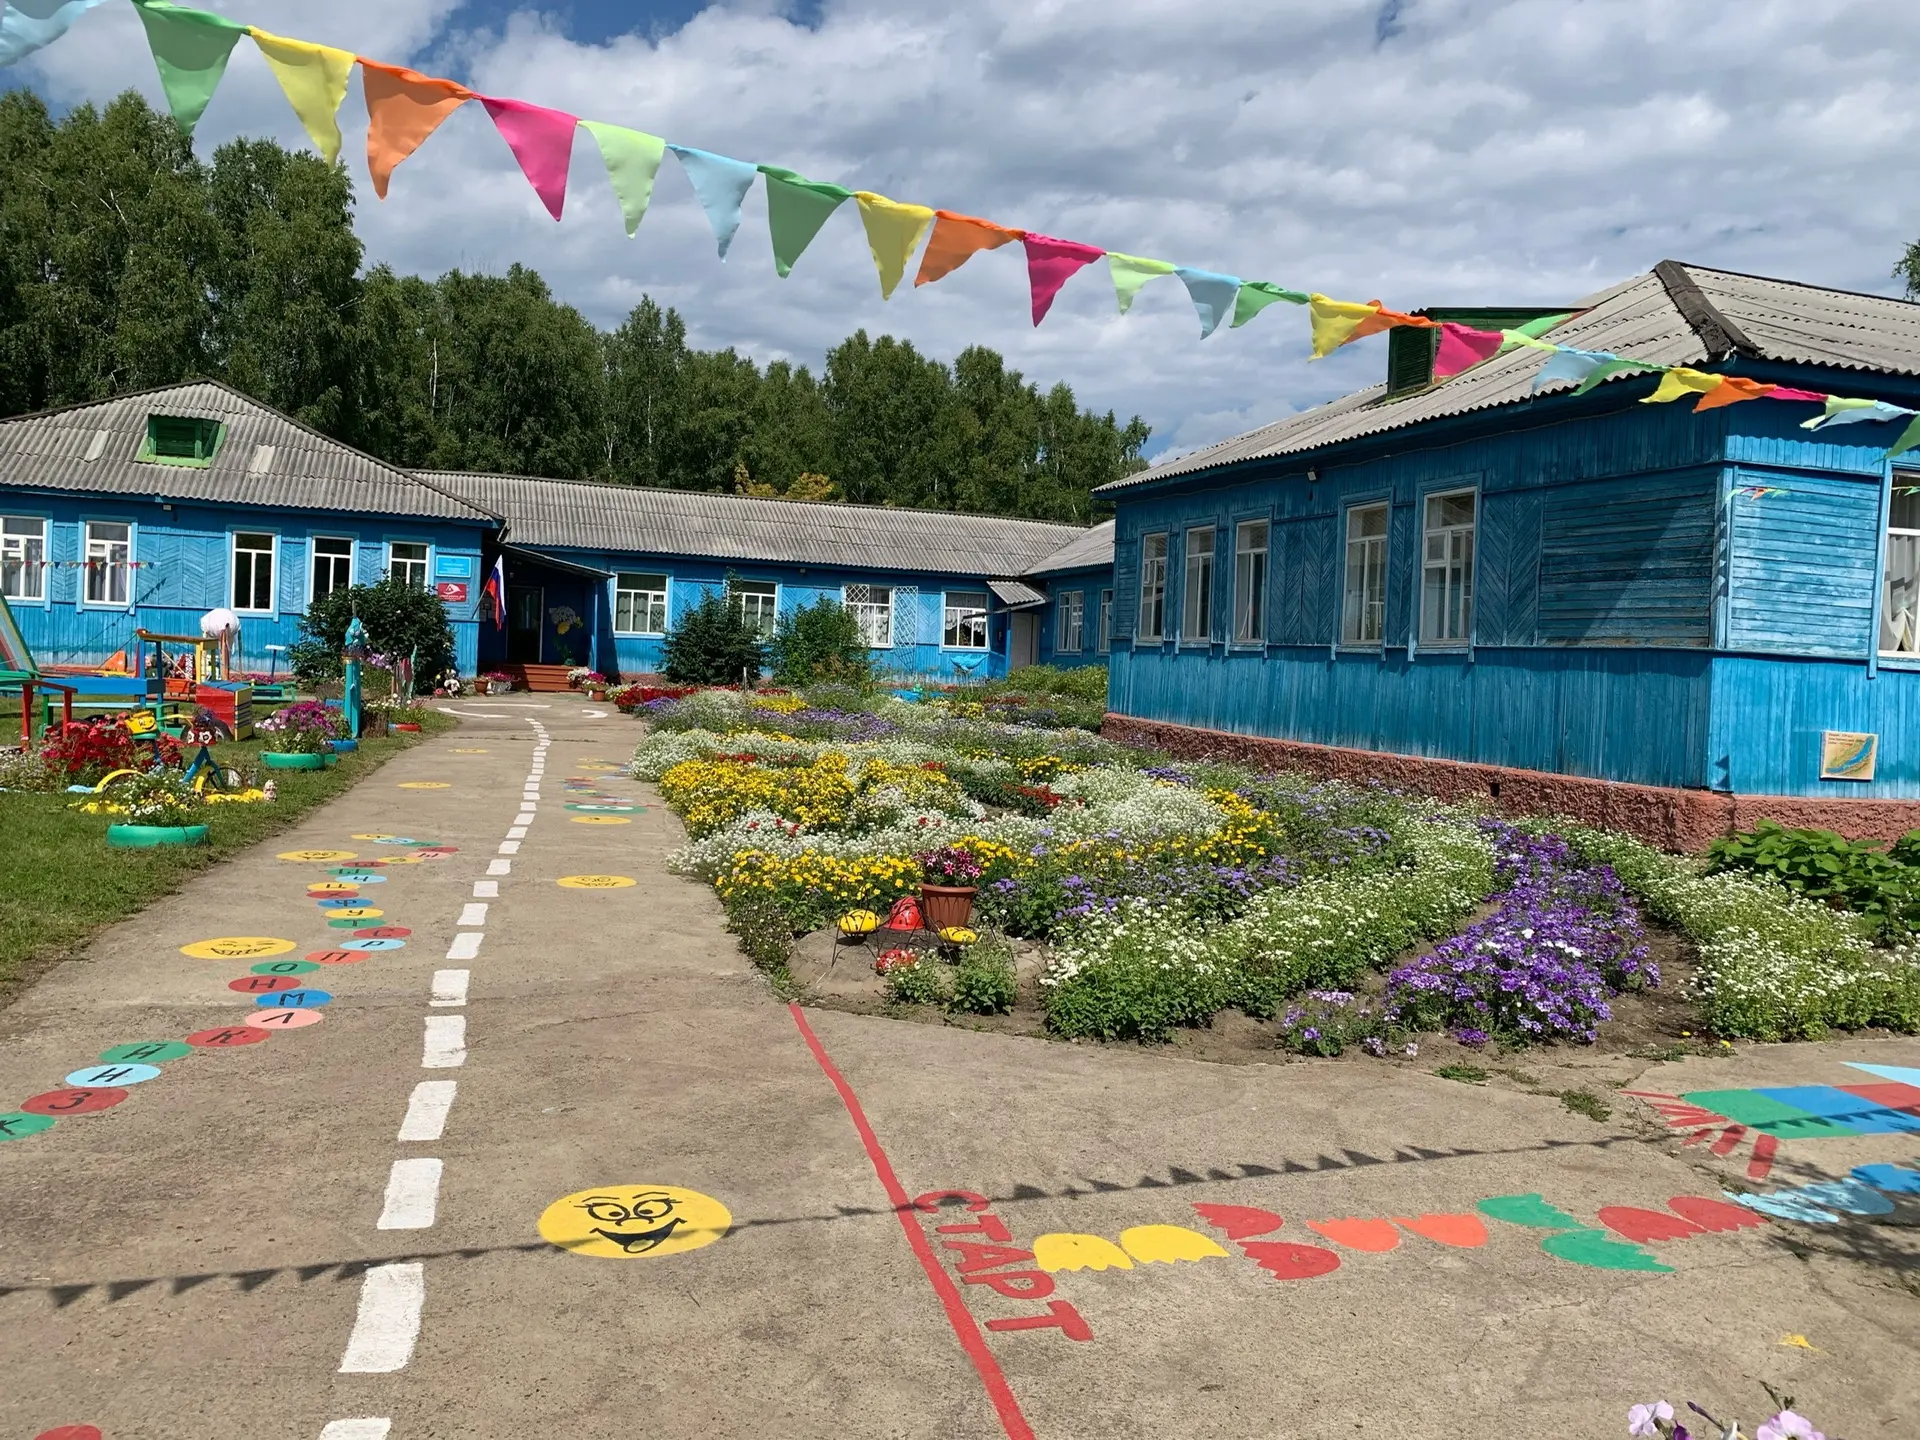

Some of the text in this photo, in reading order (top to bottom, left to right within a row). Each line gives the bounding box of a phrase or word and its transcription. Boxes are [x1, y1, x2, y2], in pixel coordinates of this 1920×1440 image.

[343, 919, 366, 927] Т
[373, 928, 395, 937] С
[361, 940, 385, 948] Р
[320, 952, 350, 962] П
[270, 962, 298, 973] О
[249, 978, 277, 990] Н
[278, 992, 306, 1006] М
[912, 1190, 1094, 1342] СТАРТ
